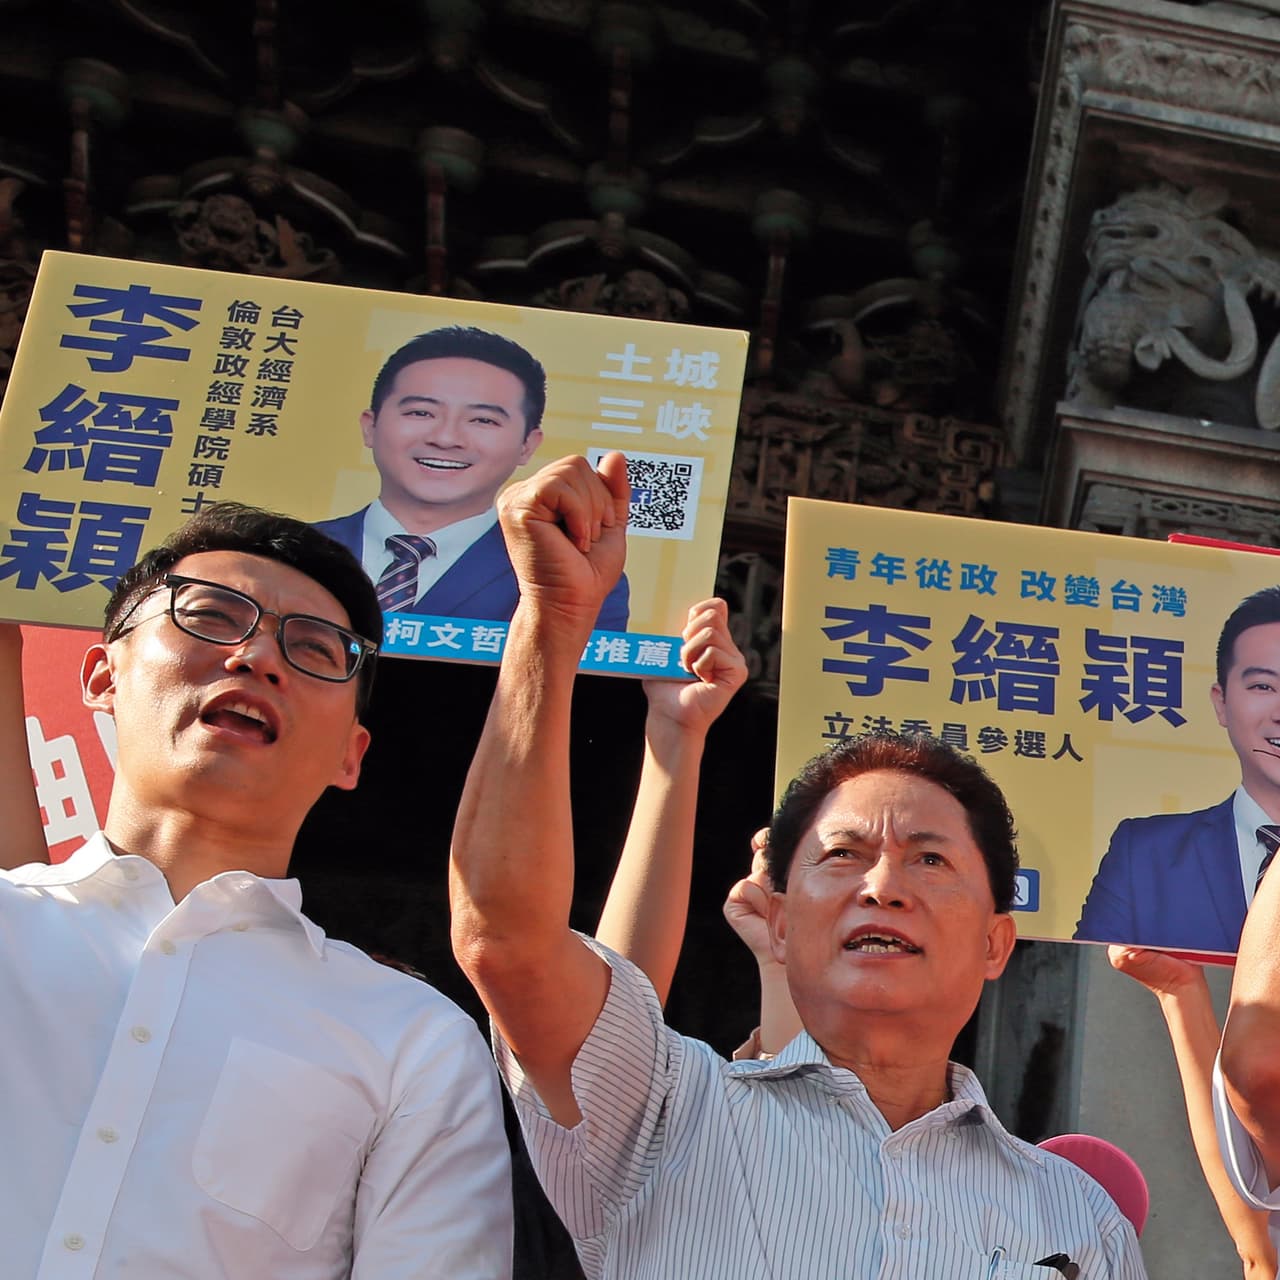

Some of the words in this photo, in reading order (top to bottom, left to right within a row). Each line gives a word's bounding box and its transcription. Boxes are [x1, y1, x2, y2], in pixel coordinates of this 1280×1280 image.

[181, 299, 262, 515] 倫敦政經學院碩士
[245, 305, 304, 437] 台大經濟系
[591, 396, 713, 441] 三峽
[598, 343, 721, 389] 土城
[1, 284, 203, 593] 李縉穎
[824, 547, 998, 596] 青年從政
[1020, 570, 1188, 618] 改變台灣
[820, 604, 1188, 728] 李縉穎
